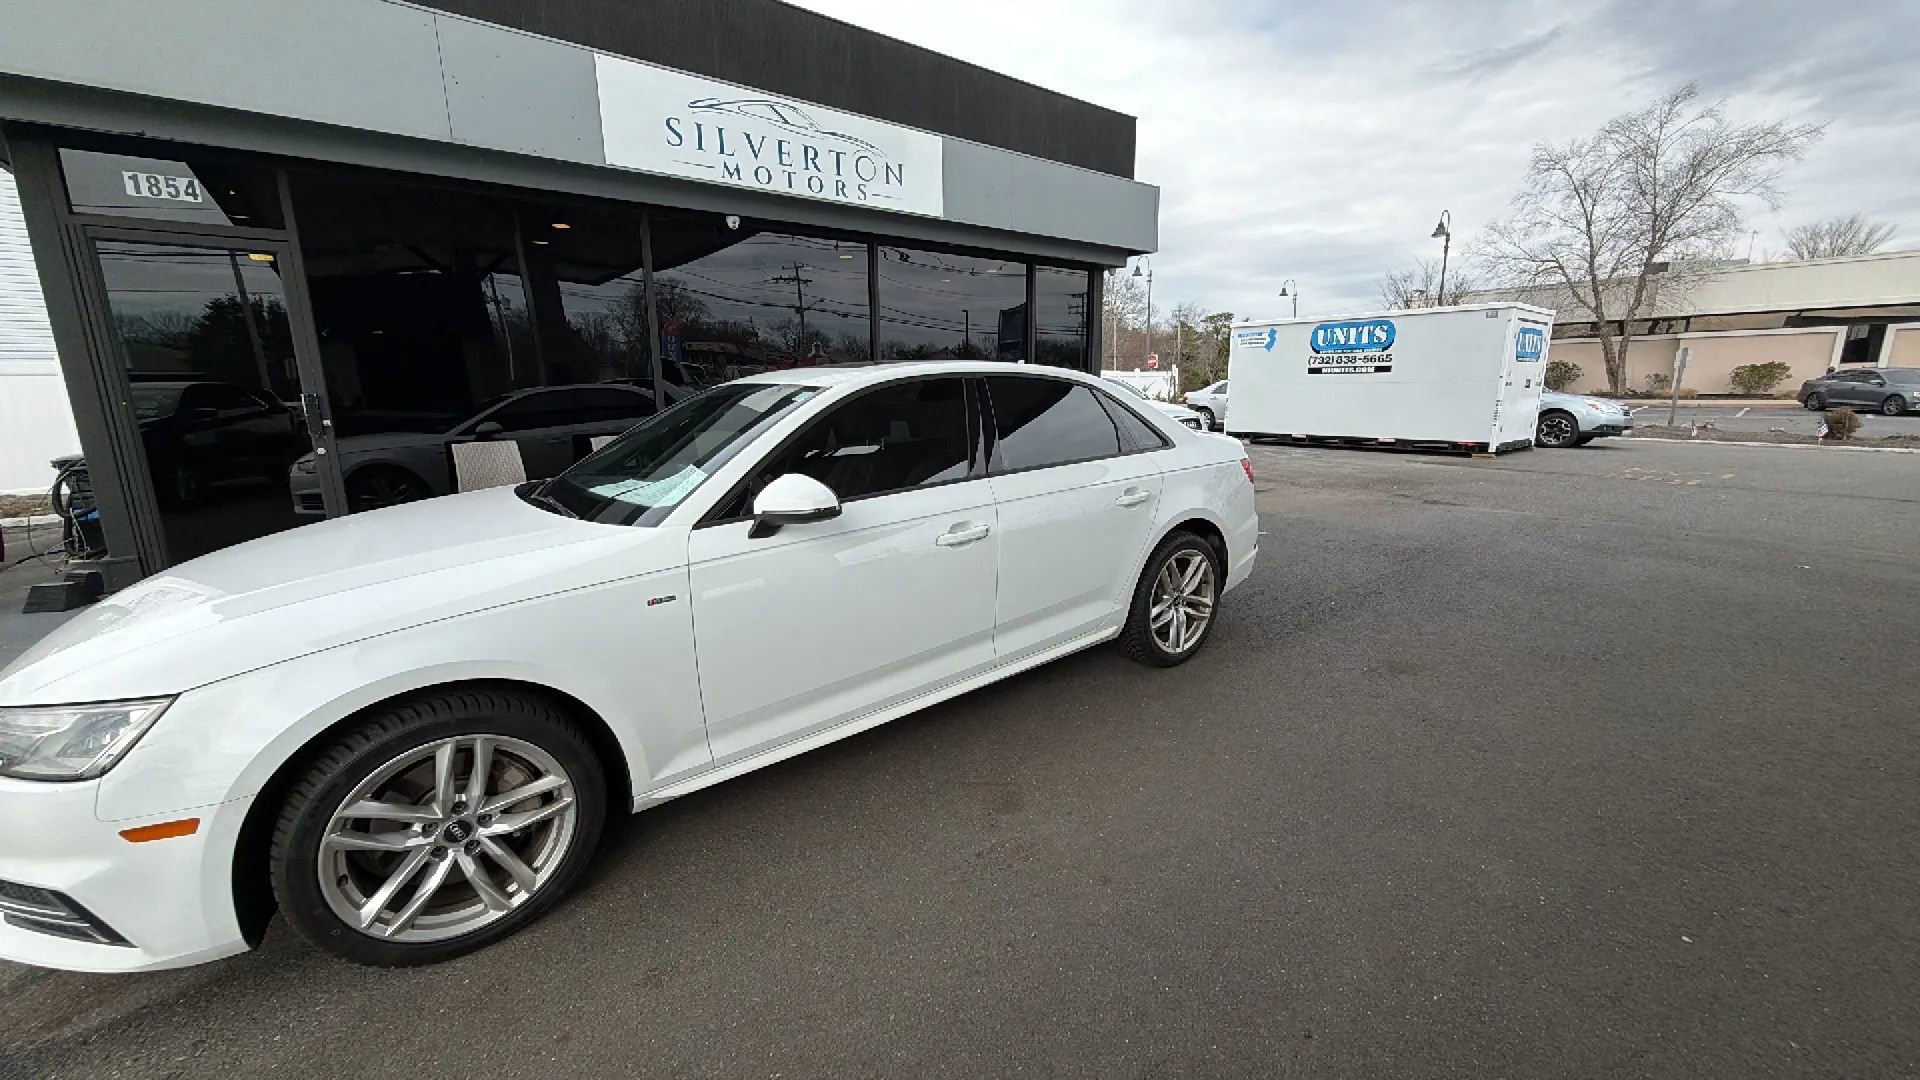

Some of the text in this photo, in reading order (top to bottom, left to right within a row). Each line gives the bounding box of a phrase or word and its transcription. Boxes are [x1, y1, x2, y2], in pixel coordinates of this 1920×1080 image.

[665, 117, 903, 187] SILVERTON
[128, 173, 199, 201] 1854
[721, 160, 868, 201] MOTORS
[1317, 325, 1388, 346] UNITS
